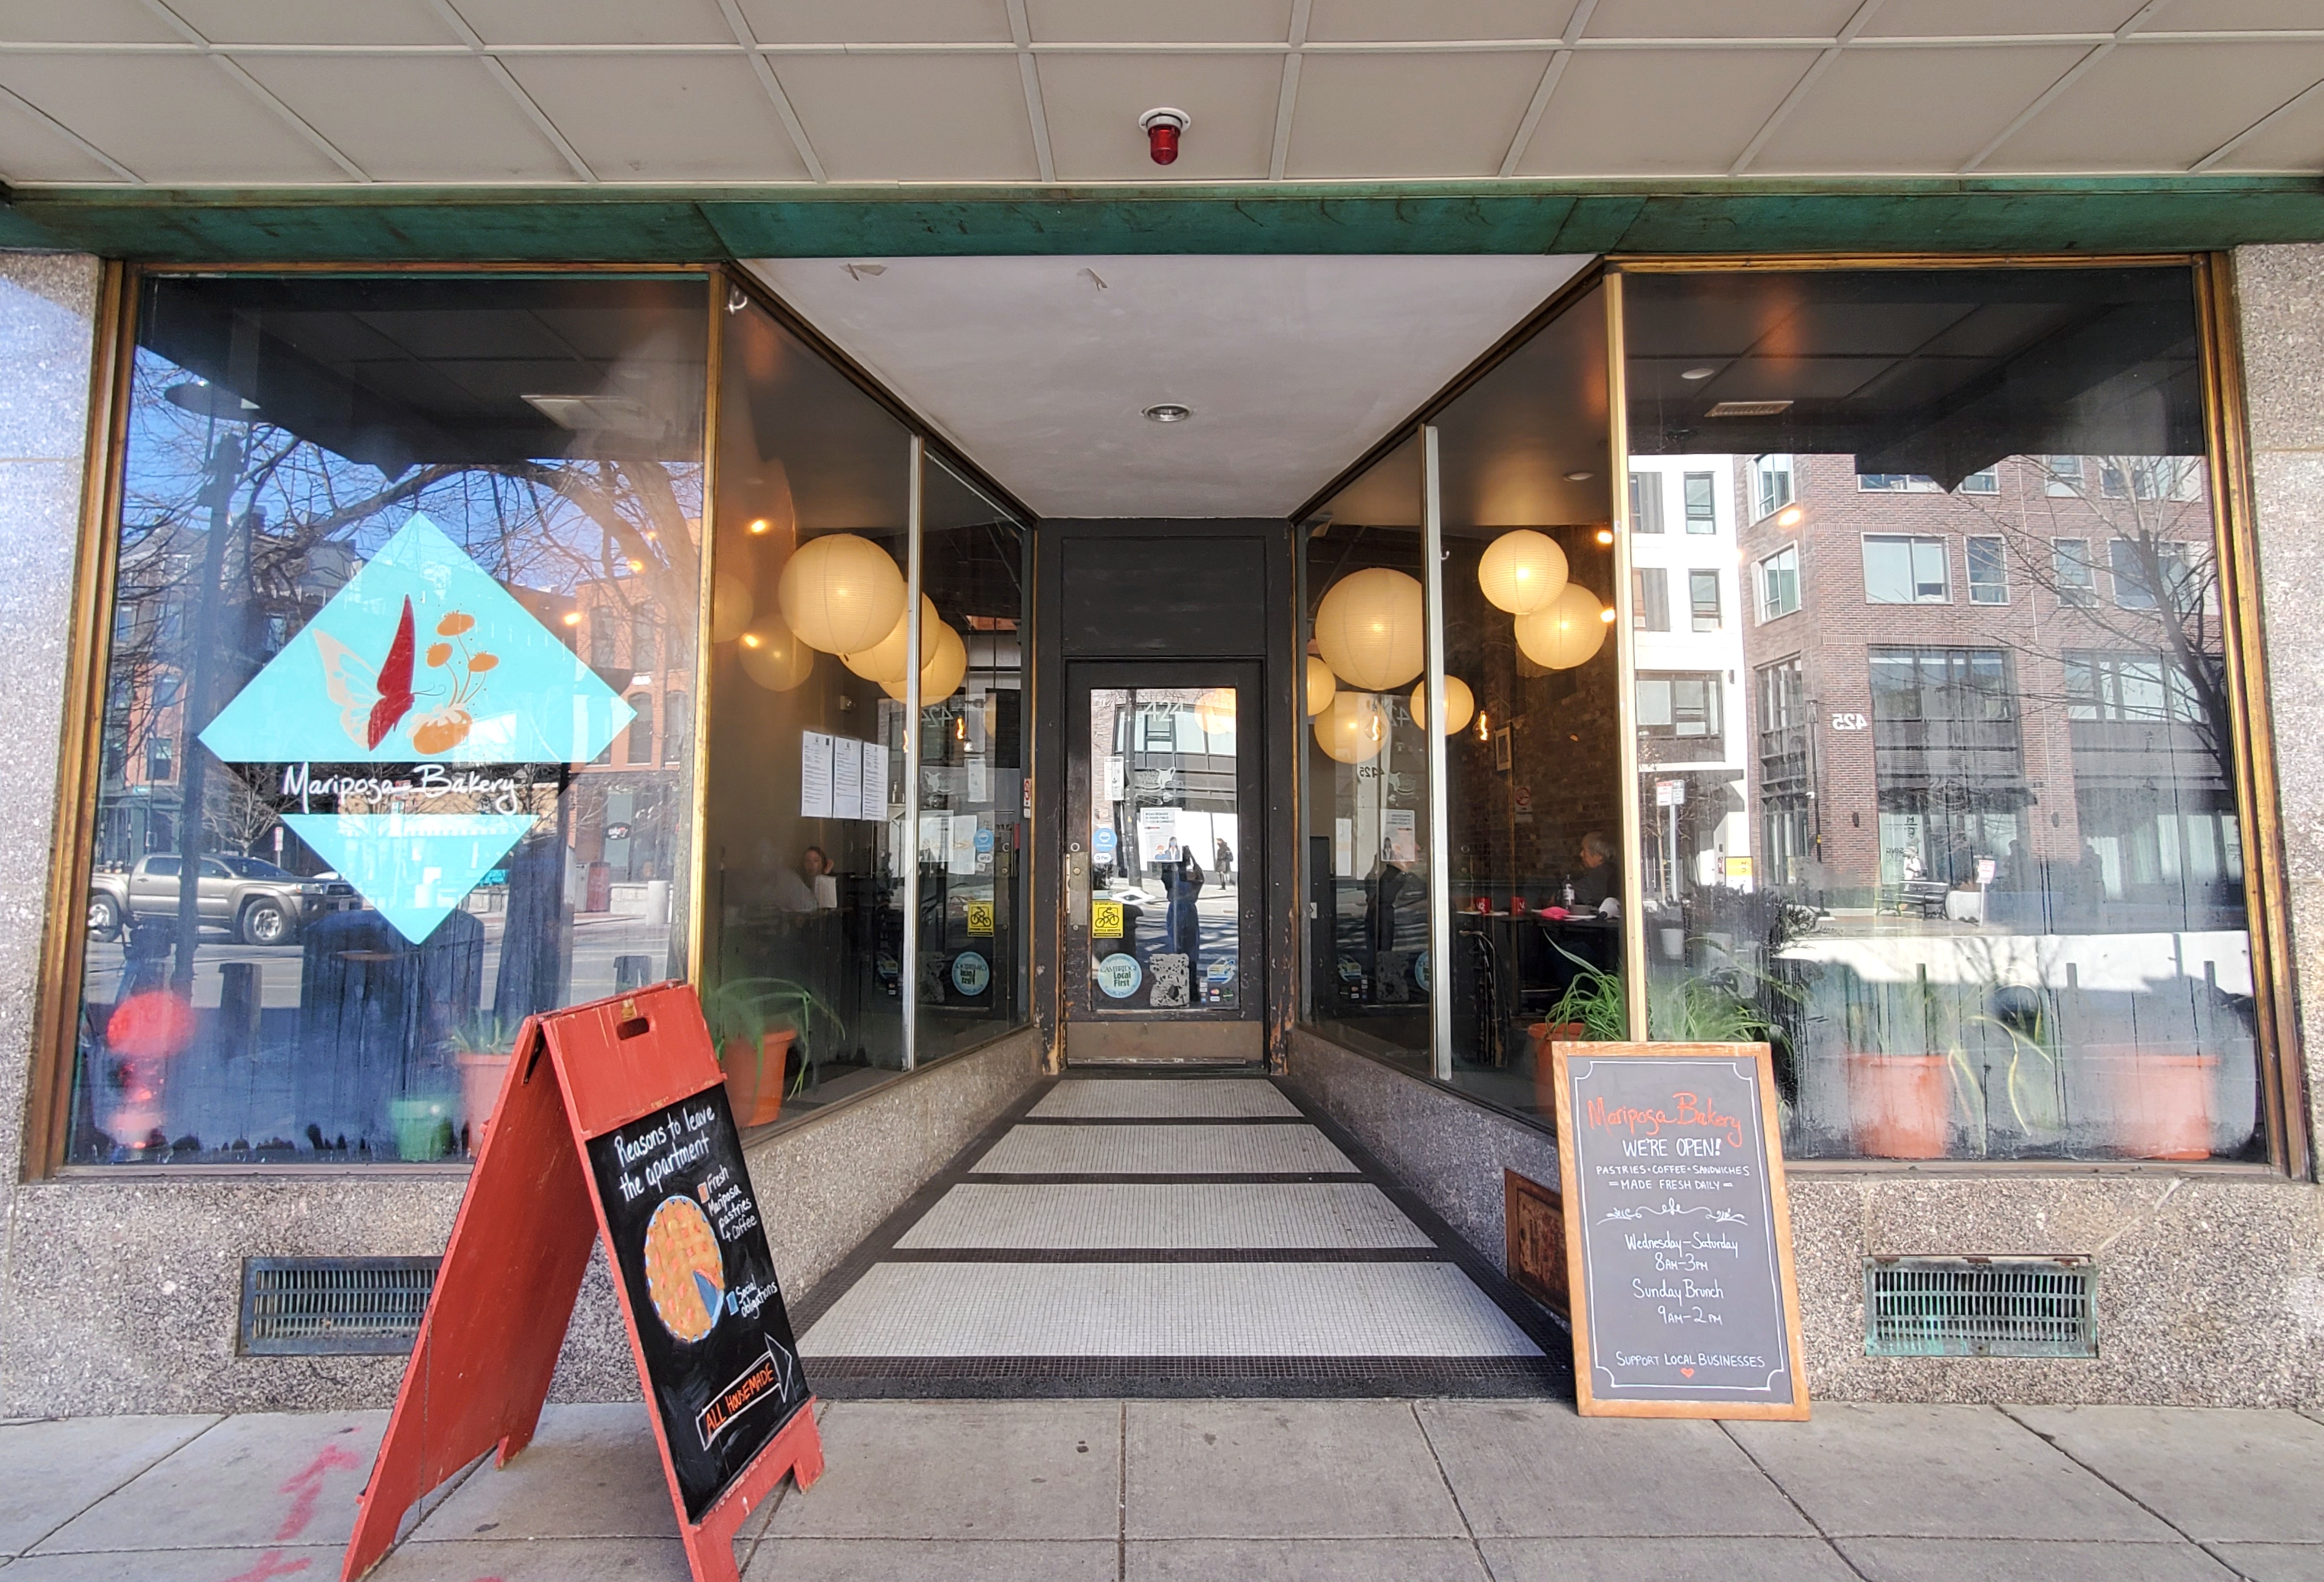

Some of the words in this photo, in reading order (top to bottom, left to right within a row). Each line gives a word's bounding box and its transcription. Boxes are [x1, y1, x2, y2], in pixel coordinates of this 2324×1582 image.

[1144, 700, 1185, 722] 424
[283, 762, 409, 814] Mariposa
[411, 764, 517, 815] Bakery
[1113, 971, 1131, 979] Local
[1114, 979, 1130, 987] First
[1587, 1097, 1677, 1137] Mariposa
[1672, 1092, 1742, 1148] Bakery
[614, 1126, 667, 1168] Reasons
[667, 1112, 682, 1140] to
[682, 1104, 715, 1132] leave
[1622, 1138, 1668, 1157] WE'RE
[1676, 1138, 1722, 1157] OPEN!
[619, 1171, 645, 1202] the
[645, 1129, 710, 1193] apartment
[706, 1164, 730, 1194] Fresh
[708, 1183, 742, 1217] Mariposa
[1620, 1179, 1652, 1190] MADE
[1659, 1180, 1692, 1190] FRESH
[1695, 1180, 1720, 1190] DAILY
[735, 1273, 757, 1305] Social
[740, 1281, 778, 1319] obligations
[1632, 1277, 1682, 1307] Sunday
[1682, 1278, 1724, 1299] Brunch
[1664, 1353, 1696, 1365] LOCAL
[1698, 1353, 1765, 1368] BUSINESSES
[705, 1402, 728, 1442] ALL
[724, 1362, 775, 1415] HOUSEMADE
